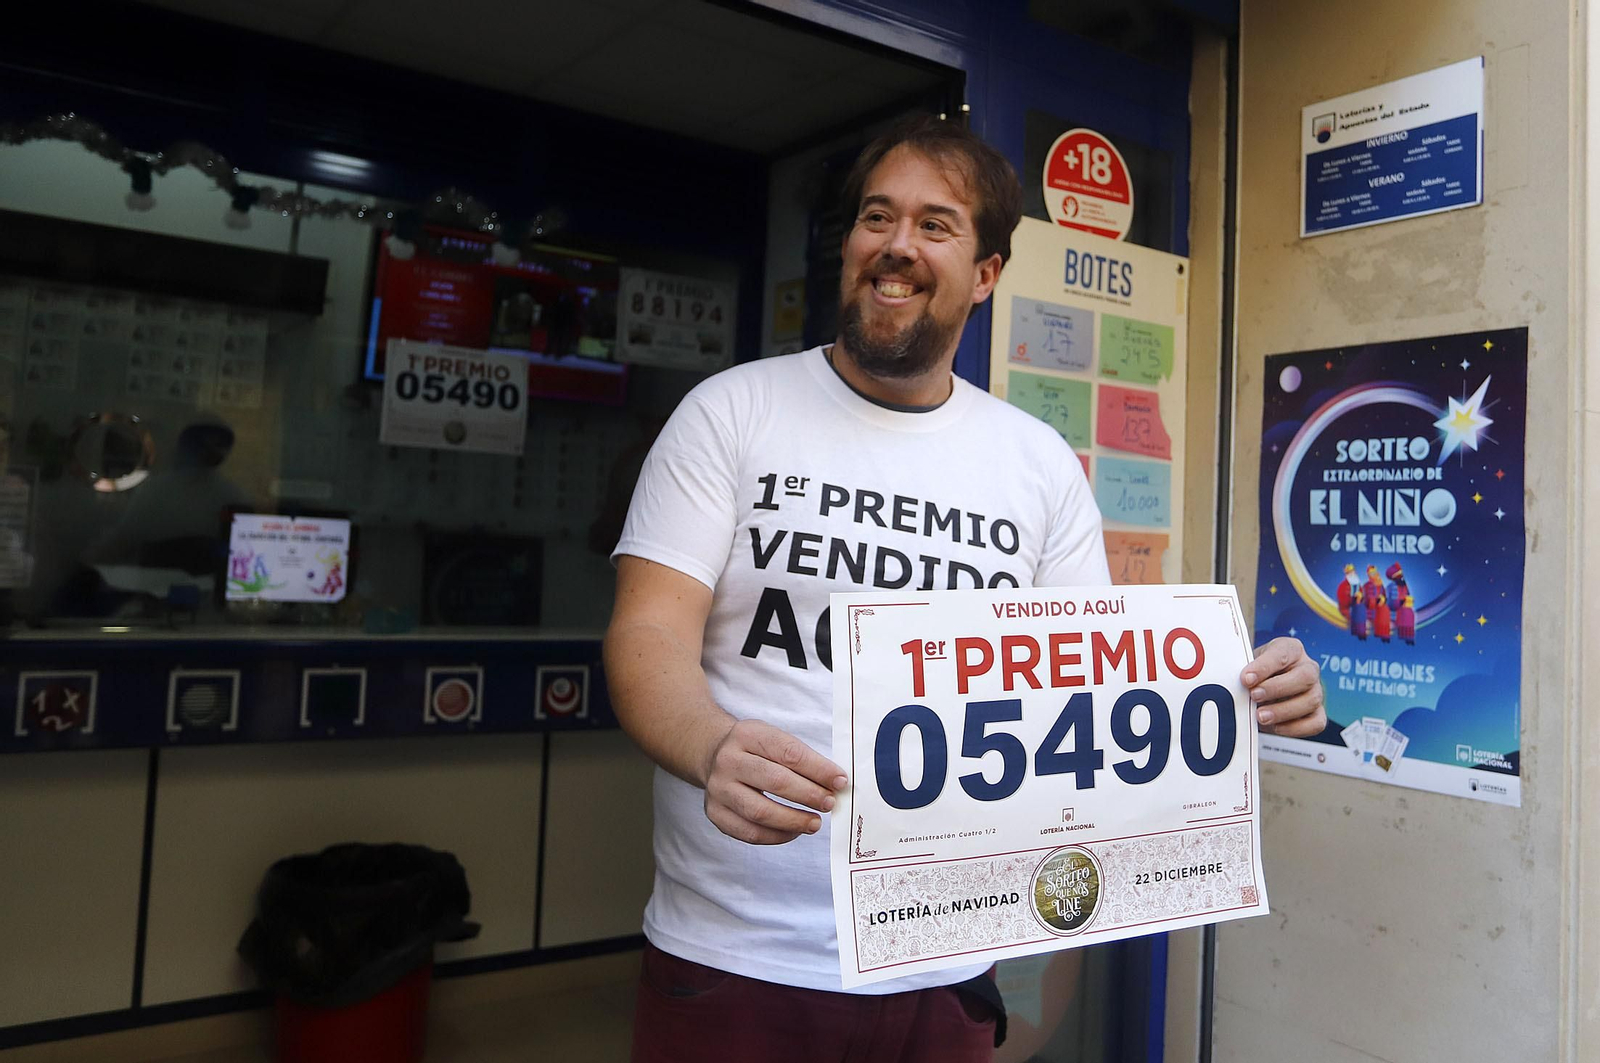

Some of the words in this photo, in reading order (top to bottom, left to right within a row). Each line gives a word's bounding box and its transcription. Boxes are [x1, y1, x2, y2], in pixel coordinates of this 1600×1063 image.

[1380, 112, 1394, 120] del
[1399, 103, 1430, 116] Estado
[1366, 130, 1408, 148] INVIERNO
[1422, 134, 1446, 146] Sábados
[1063, 143, 1112, 186] +18
[1368, 172, 1405, 188] VERANO
[1421, 176, 1446, 187] Sábados
[1064, 248, 1133, 297] BOTES
[632, 292, 723, 324] 88194
[424, 355, 510, 382] PREMIO
[396, 371, 520, 410] 05490
[1336, 436, 1430, 463] SORTEO
[1323, 468, 1424, 482] EXTRAORDINARIO
[1426, 467, 1442, 480] DE
[818, 482, 1020, 556] PREMIO
[1310, 489, 1347, 525] EL
[1358, 488, 1456, 527] NIÑO
[1330, 533, 1342, 552] 6
[1346, 533, 1367, 552] DE
[1372, 534, 1434, 554] ENERO
[992, 602, 1077, 618] VENDIDO
[1083, 595, 1126, 616] AQUÍ
[901, 638, 948, 698] 1er
[955, 627, 1206, 694] PREMIO
[1320, 654, 1352, 674] 700
[1355, 659, 1436, 684] MILLONES
[1338, 676, 1356, 691] EN
[1358, 678, 1416, 698] PREMIOS
[874, 683, 1237, 810] 05490
[1474, 758, 1513, 770] NACIONAL
[898, 833, 956, 844] Administración
[958, 830, 983, 838] Cuatro
[986, 828, 997, 836] 1/2
[1040, 826, 1064, 836] LOTERÍA
[1065, 823, 1096, 832] NACIONAL
[1044, 866, 1090, 897] SORTEO
[1135, 873, 1150, 885] 22
[1154, 862, 1223, 882] DICIEMBRE
[1056, 888, 1072, 900] QUE
[1072, 881, 1089, 897] NOS
[870, 902, 932, 926] LOTERÍA
[934, 903, 950, 916] de
[952, 892, 1020, 913] NAVIDAD
[1052, 896, 1082, 922] UNE
